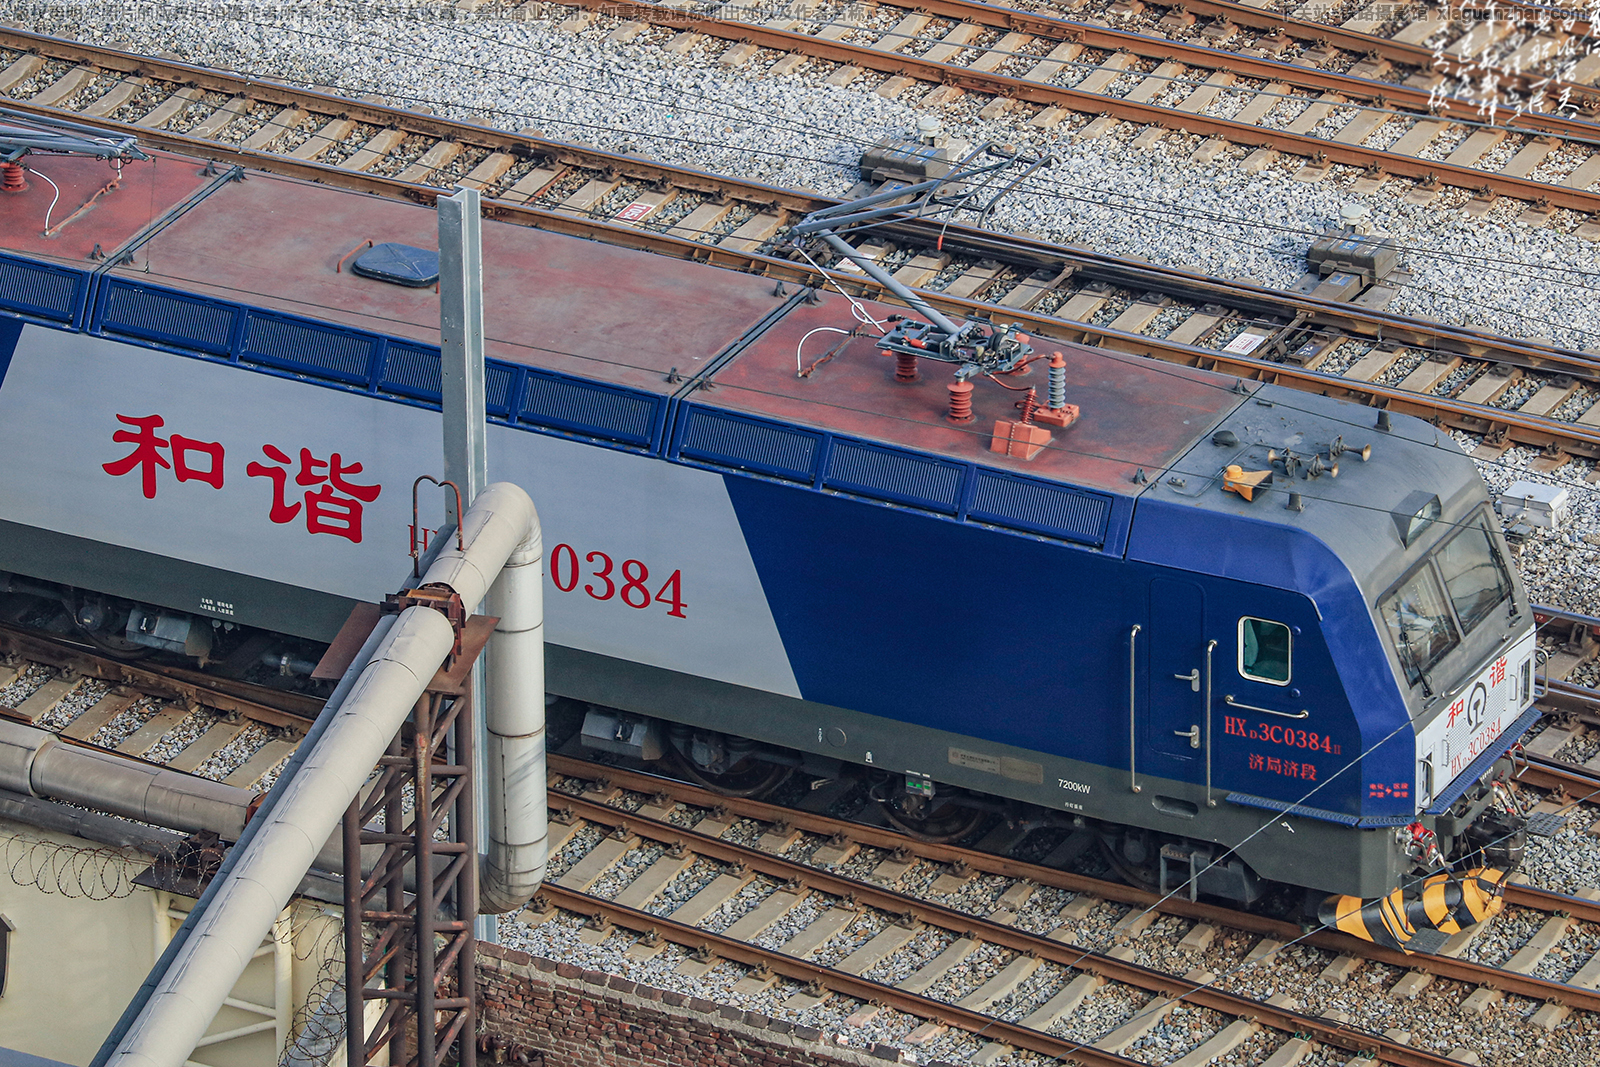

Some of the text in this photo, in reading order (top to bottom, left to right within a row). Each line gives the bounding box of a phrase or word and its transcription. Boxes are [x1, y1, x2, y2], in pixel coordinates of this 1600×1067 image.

[102, 413, 381, 543] 和谐
[1446, 655, 1508, 729] 和 谐
[1057, 778, 1091, 794] 7200kW
[1248, 752, 1317, 781] 济局济段
